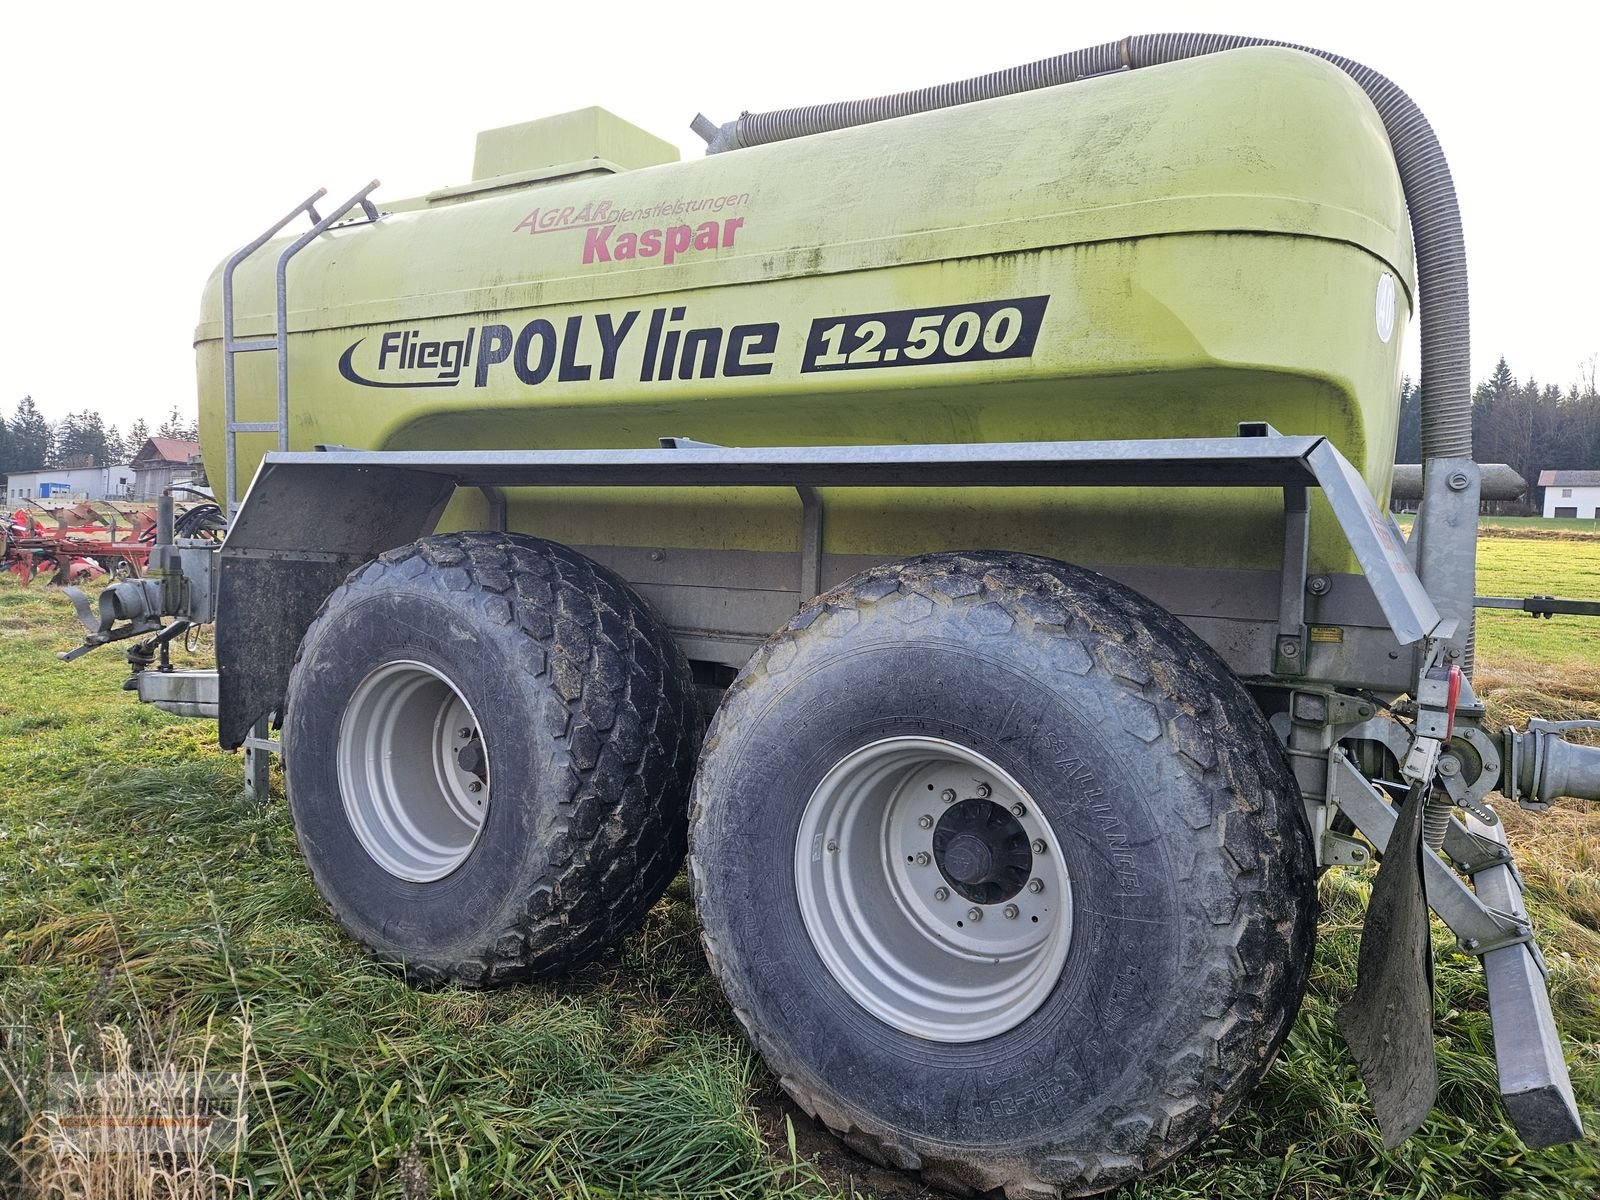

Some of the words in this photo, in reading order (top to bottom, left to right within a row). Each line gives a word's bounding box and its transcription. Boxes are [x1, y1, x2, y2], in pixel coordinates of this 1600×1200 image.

[582, 216, 745, 265] Kaspar
[378, 327, 475, 379] Fliegl
[814, 307, 1023, 367] 12.500
[1055, 757, 1141, 891] ALLIANCE
